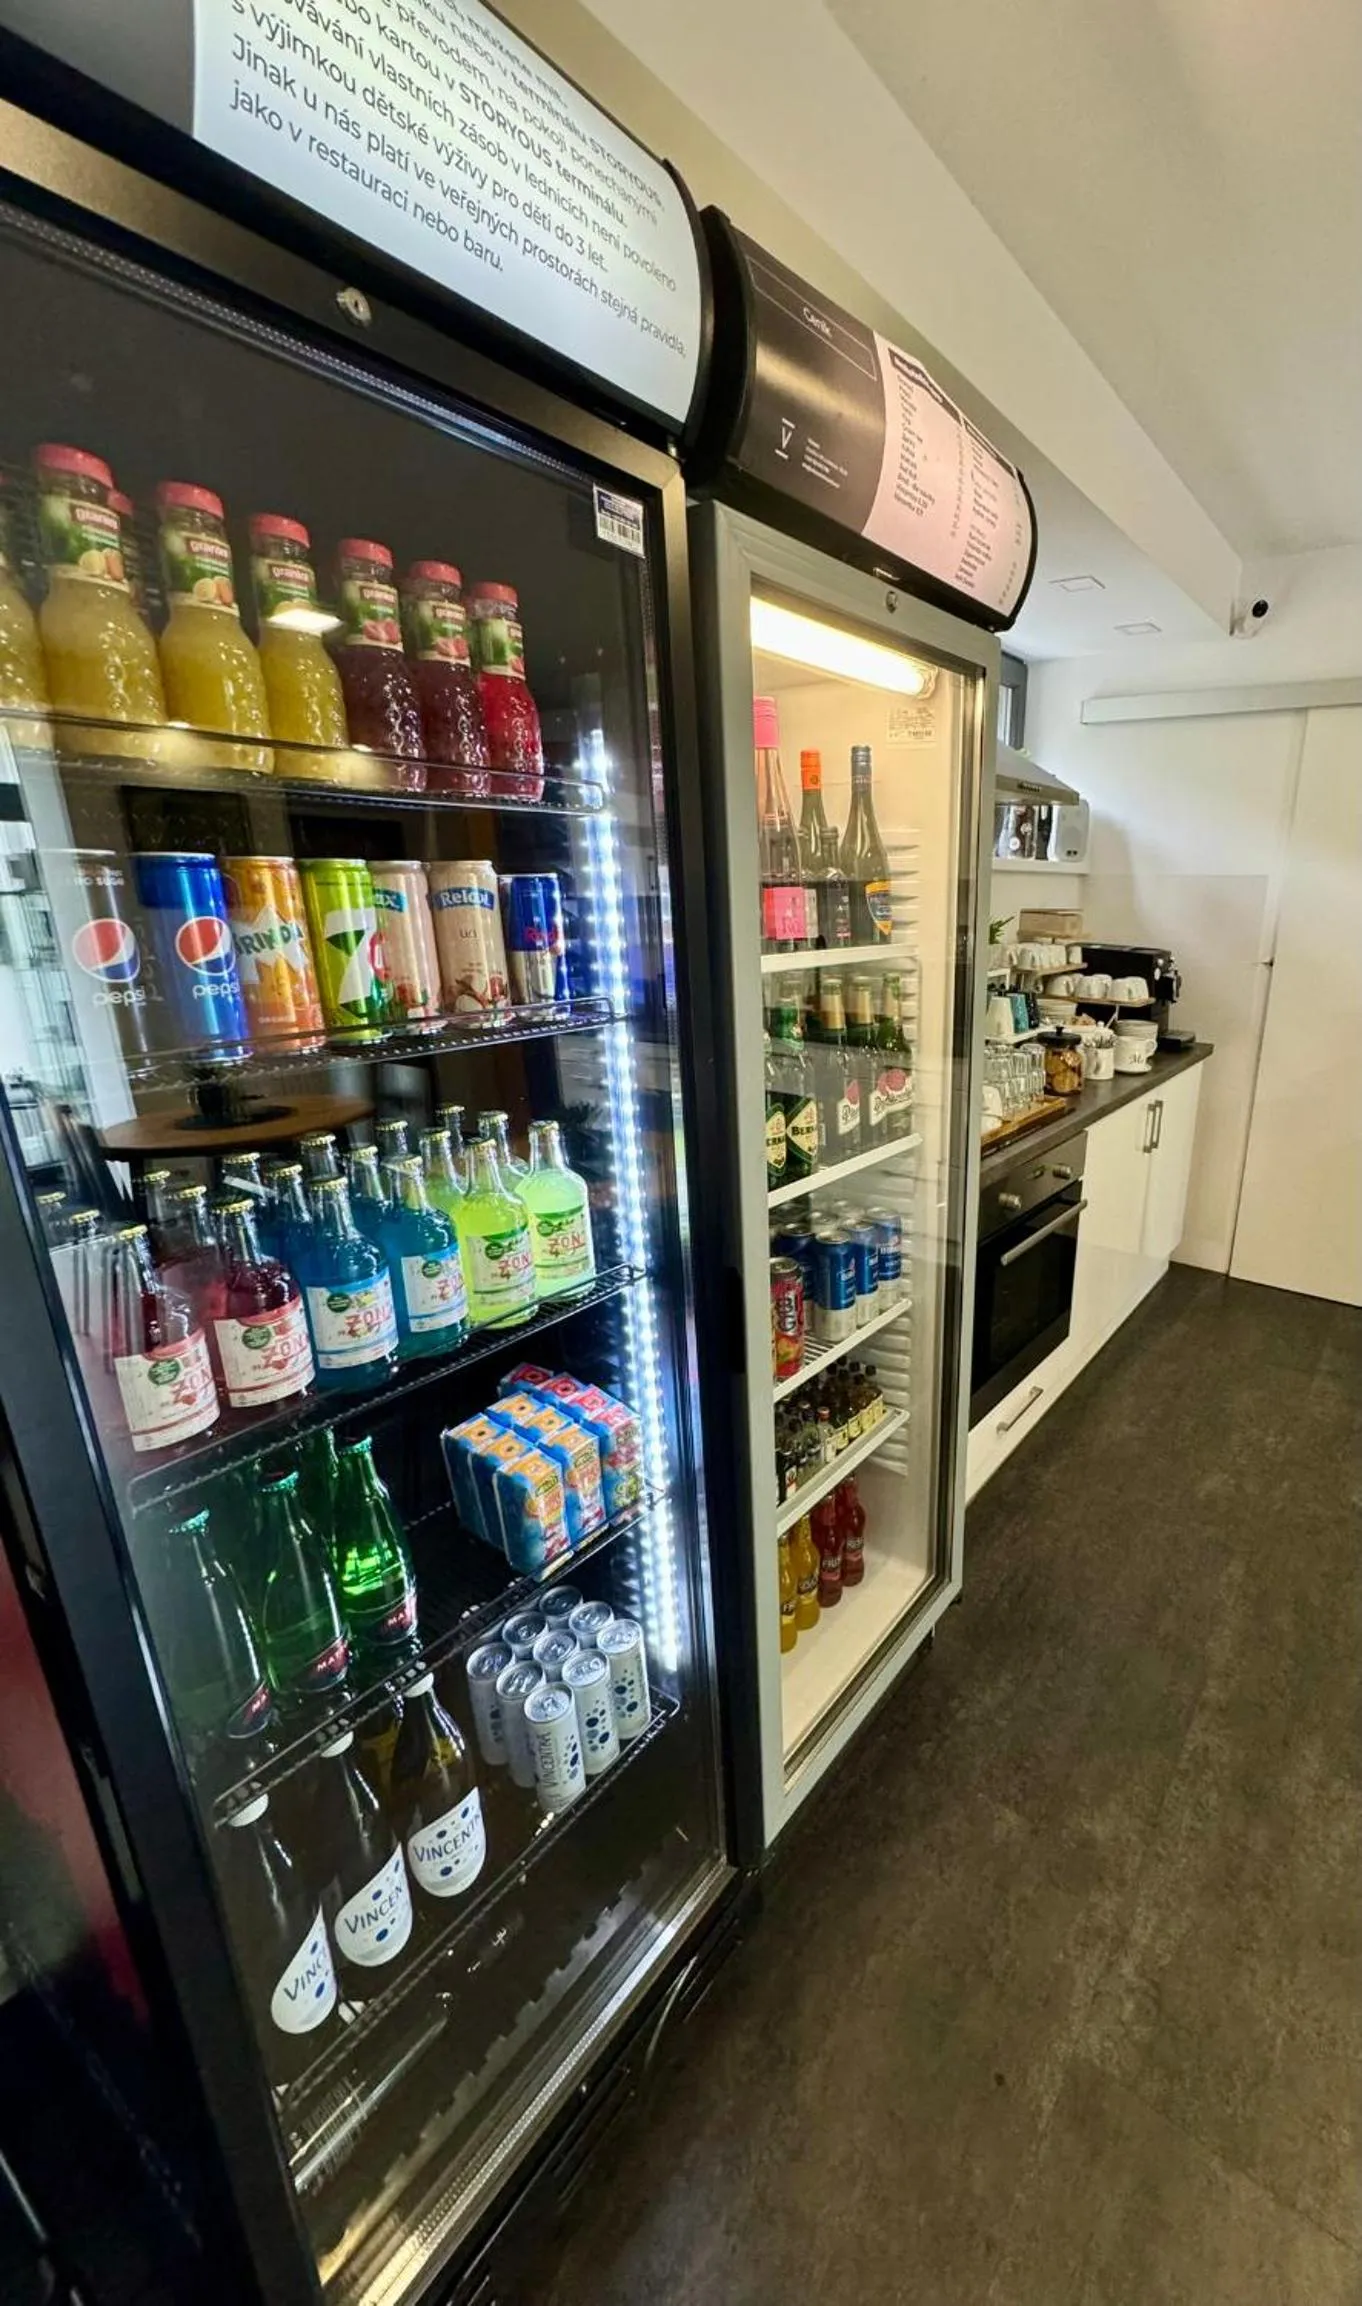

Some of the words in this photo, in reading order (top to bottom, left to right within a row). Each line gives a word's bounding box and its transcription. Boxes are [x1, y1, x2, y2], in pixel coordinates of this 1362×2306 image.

[229, 79, 283, 131] jako
[289, 121, 302, 142] v
[308, 135, 409, 212] restauraci
[412, 201, 460, 243] nebo
[463, 229, 504, 272] baru.
[232, 32, 297, 99] Jinak
[303, 86, 317, 111] u
[325, 101, 361, 140] nás
[368, 131, 410, 173] platí
[413, 161, 436, 189] ve
[439, 178, 519, 240] veřejných
[522, 237, 600, 299] prostorách
[600, 289, 638, 327] stejná
[250, 4, 356, 95] výjimkou
[362, 86, 429, 146] dětské
[433, 134, 488, 191] výživy
[492, 179, 519, 209] pro
[555, 223, 573, 248] do
[576, 235, 586, 257] 3
[368, 49, 455, 128] vlastních
[458, 118, 508, 167] zásob
[510, 157, 522, 176] v
[524, 163, 589, 229] lednicích
[376, 13, 440, 81] kartou
[444, 73, 456, 92] v
[459, 82, 552, 168] STORYOUS
